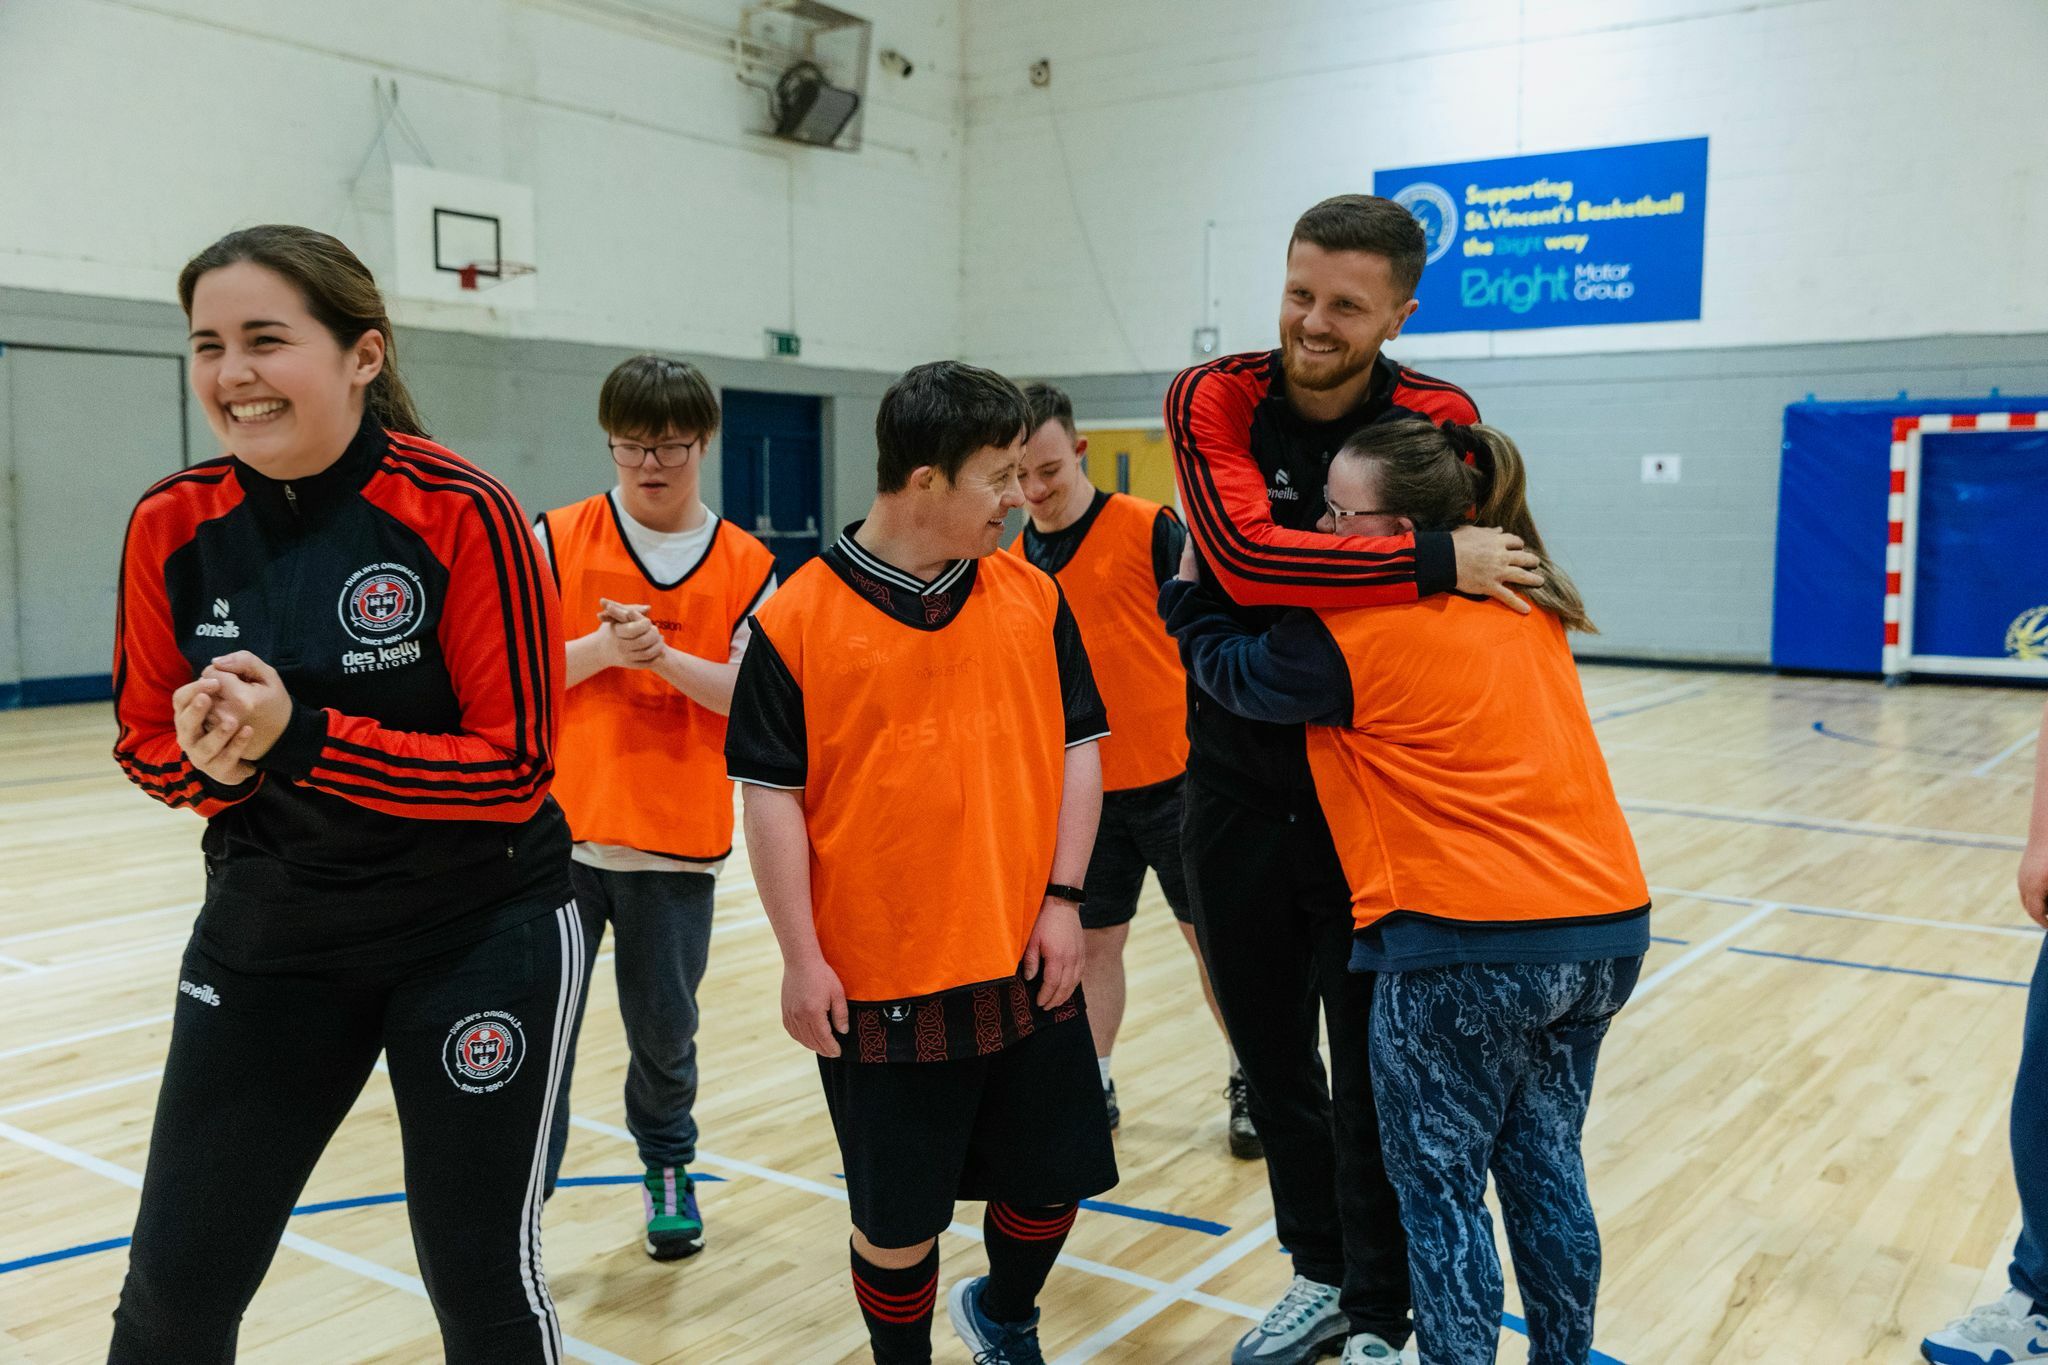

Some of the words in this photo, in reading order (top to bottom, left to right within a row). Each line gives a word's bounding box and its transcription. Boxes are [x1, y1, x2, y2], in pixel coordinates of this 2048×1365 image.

[1465, 178, 1573, 207] Supporting
[1577, 191, 1685, 222] Basketball
[1463, 236, 1494, 257] the
[1544, 233, 1589, 254] way
[1574, 262, 1632, 283] Motor
[1461, 264, 1569, 314] Bright
[1573, 281, 1635, 301] Group
[345, 563, 379, 587] DUBLIN'S
[380, 562, 420, 582] ORIGINALS
[342, 650, 376, 667] des
[378, 640, 421, 663] kelly
[344, 655, 416, 674] INTERIORS
[449, 1012, 481, 1034] DUBLIN'S
[483, 1010, 521, 1028] ORIGINALS
[461, 1083, 484, 1094] SINCE
